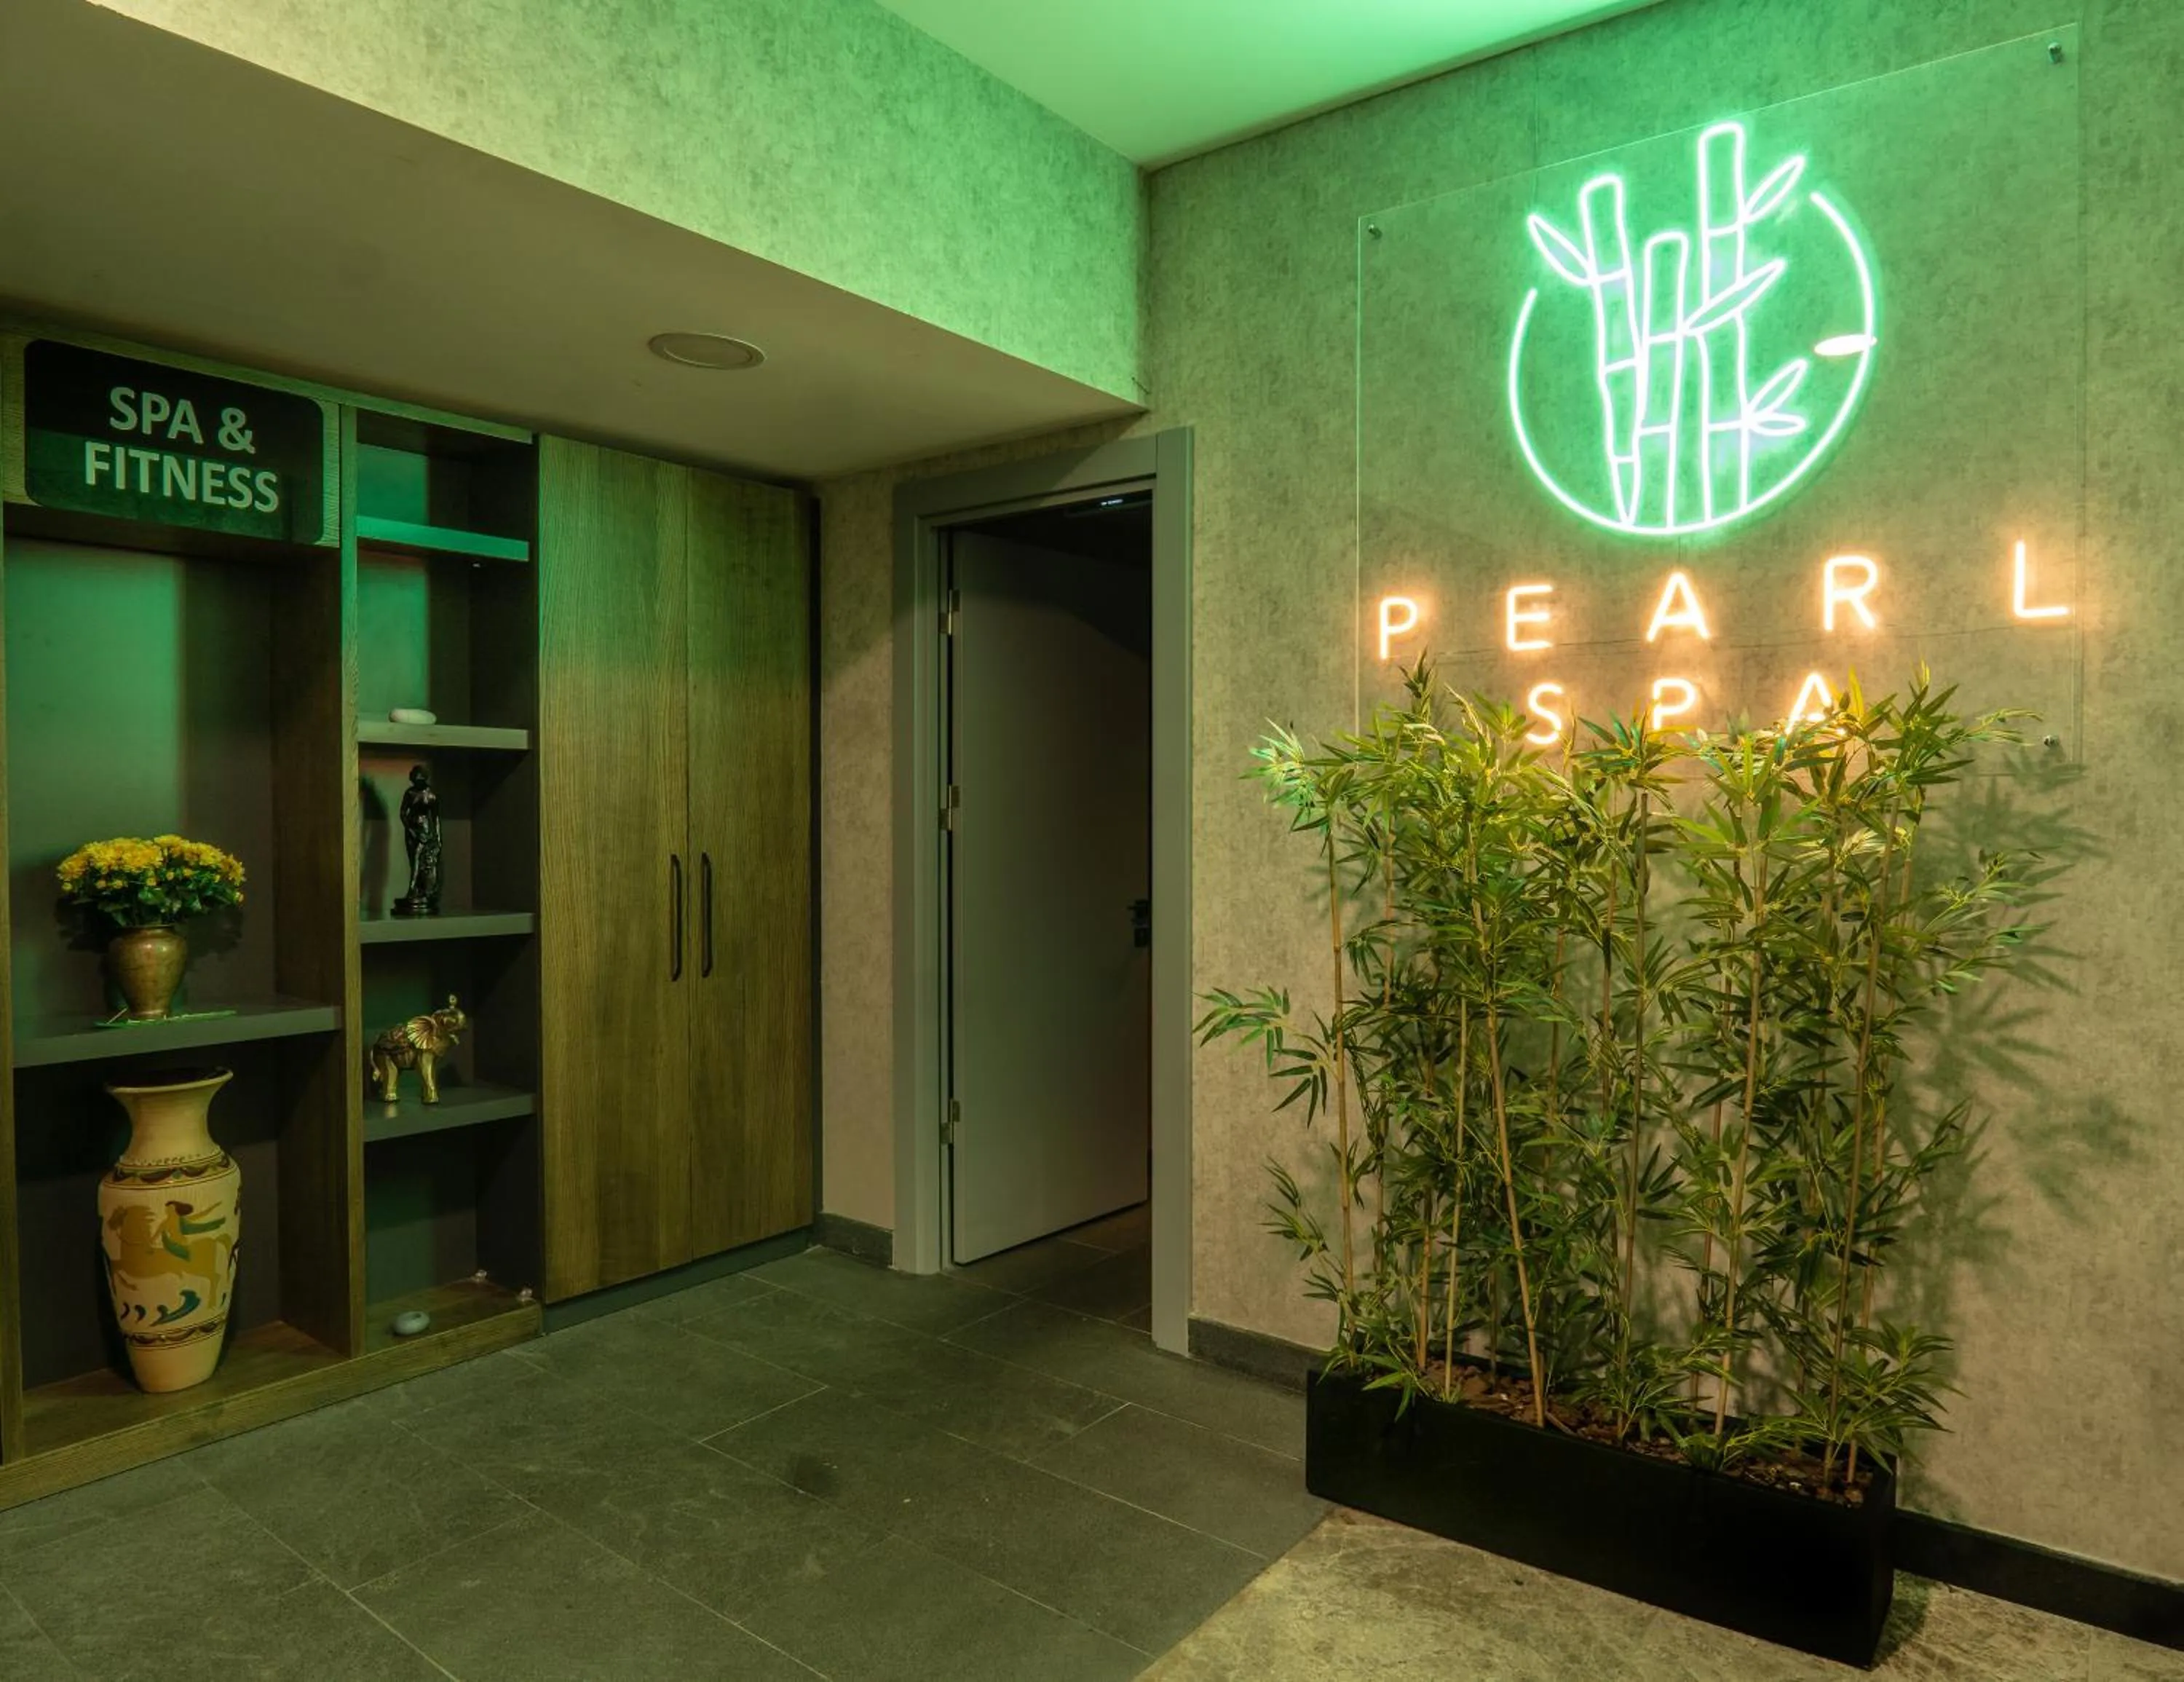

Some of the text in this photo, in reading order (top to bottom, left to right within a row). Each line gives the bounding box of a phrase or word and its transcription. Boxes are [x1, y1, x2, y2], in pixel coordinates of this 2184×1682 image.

[109, 387, 256, 454] SPA &
[85, 441, 279, 513] FITNESS
[1378, 540, 2070, 660] PEARL
[1526, 672, 1844, 744] SPA
